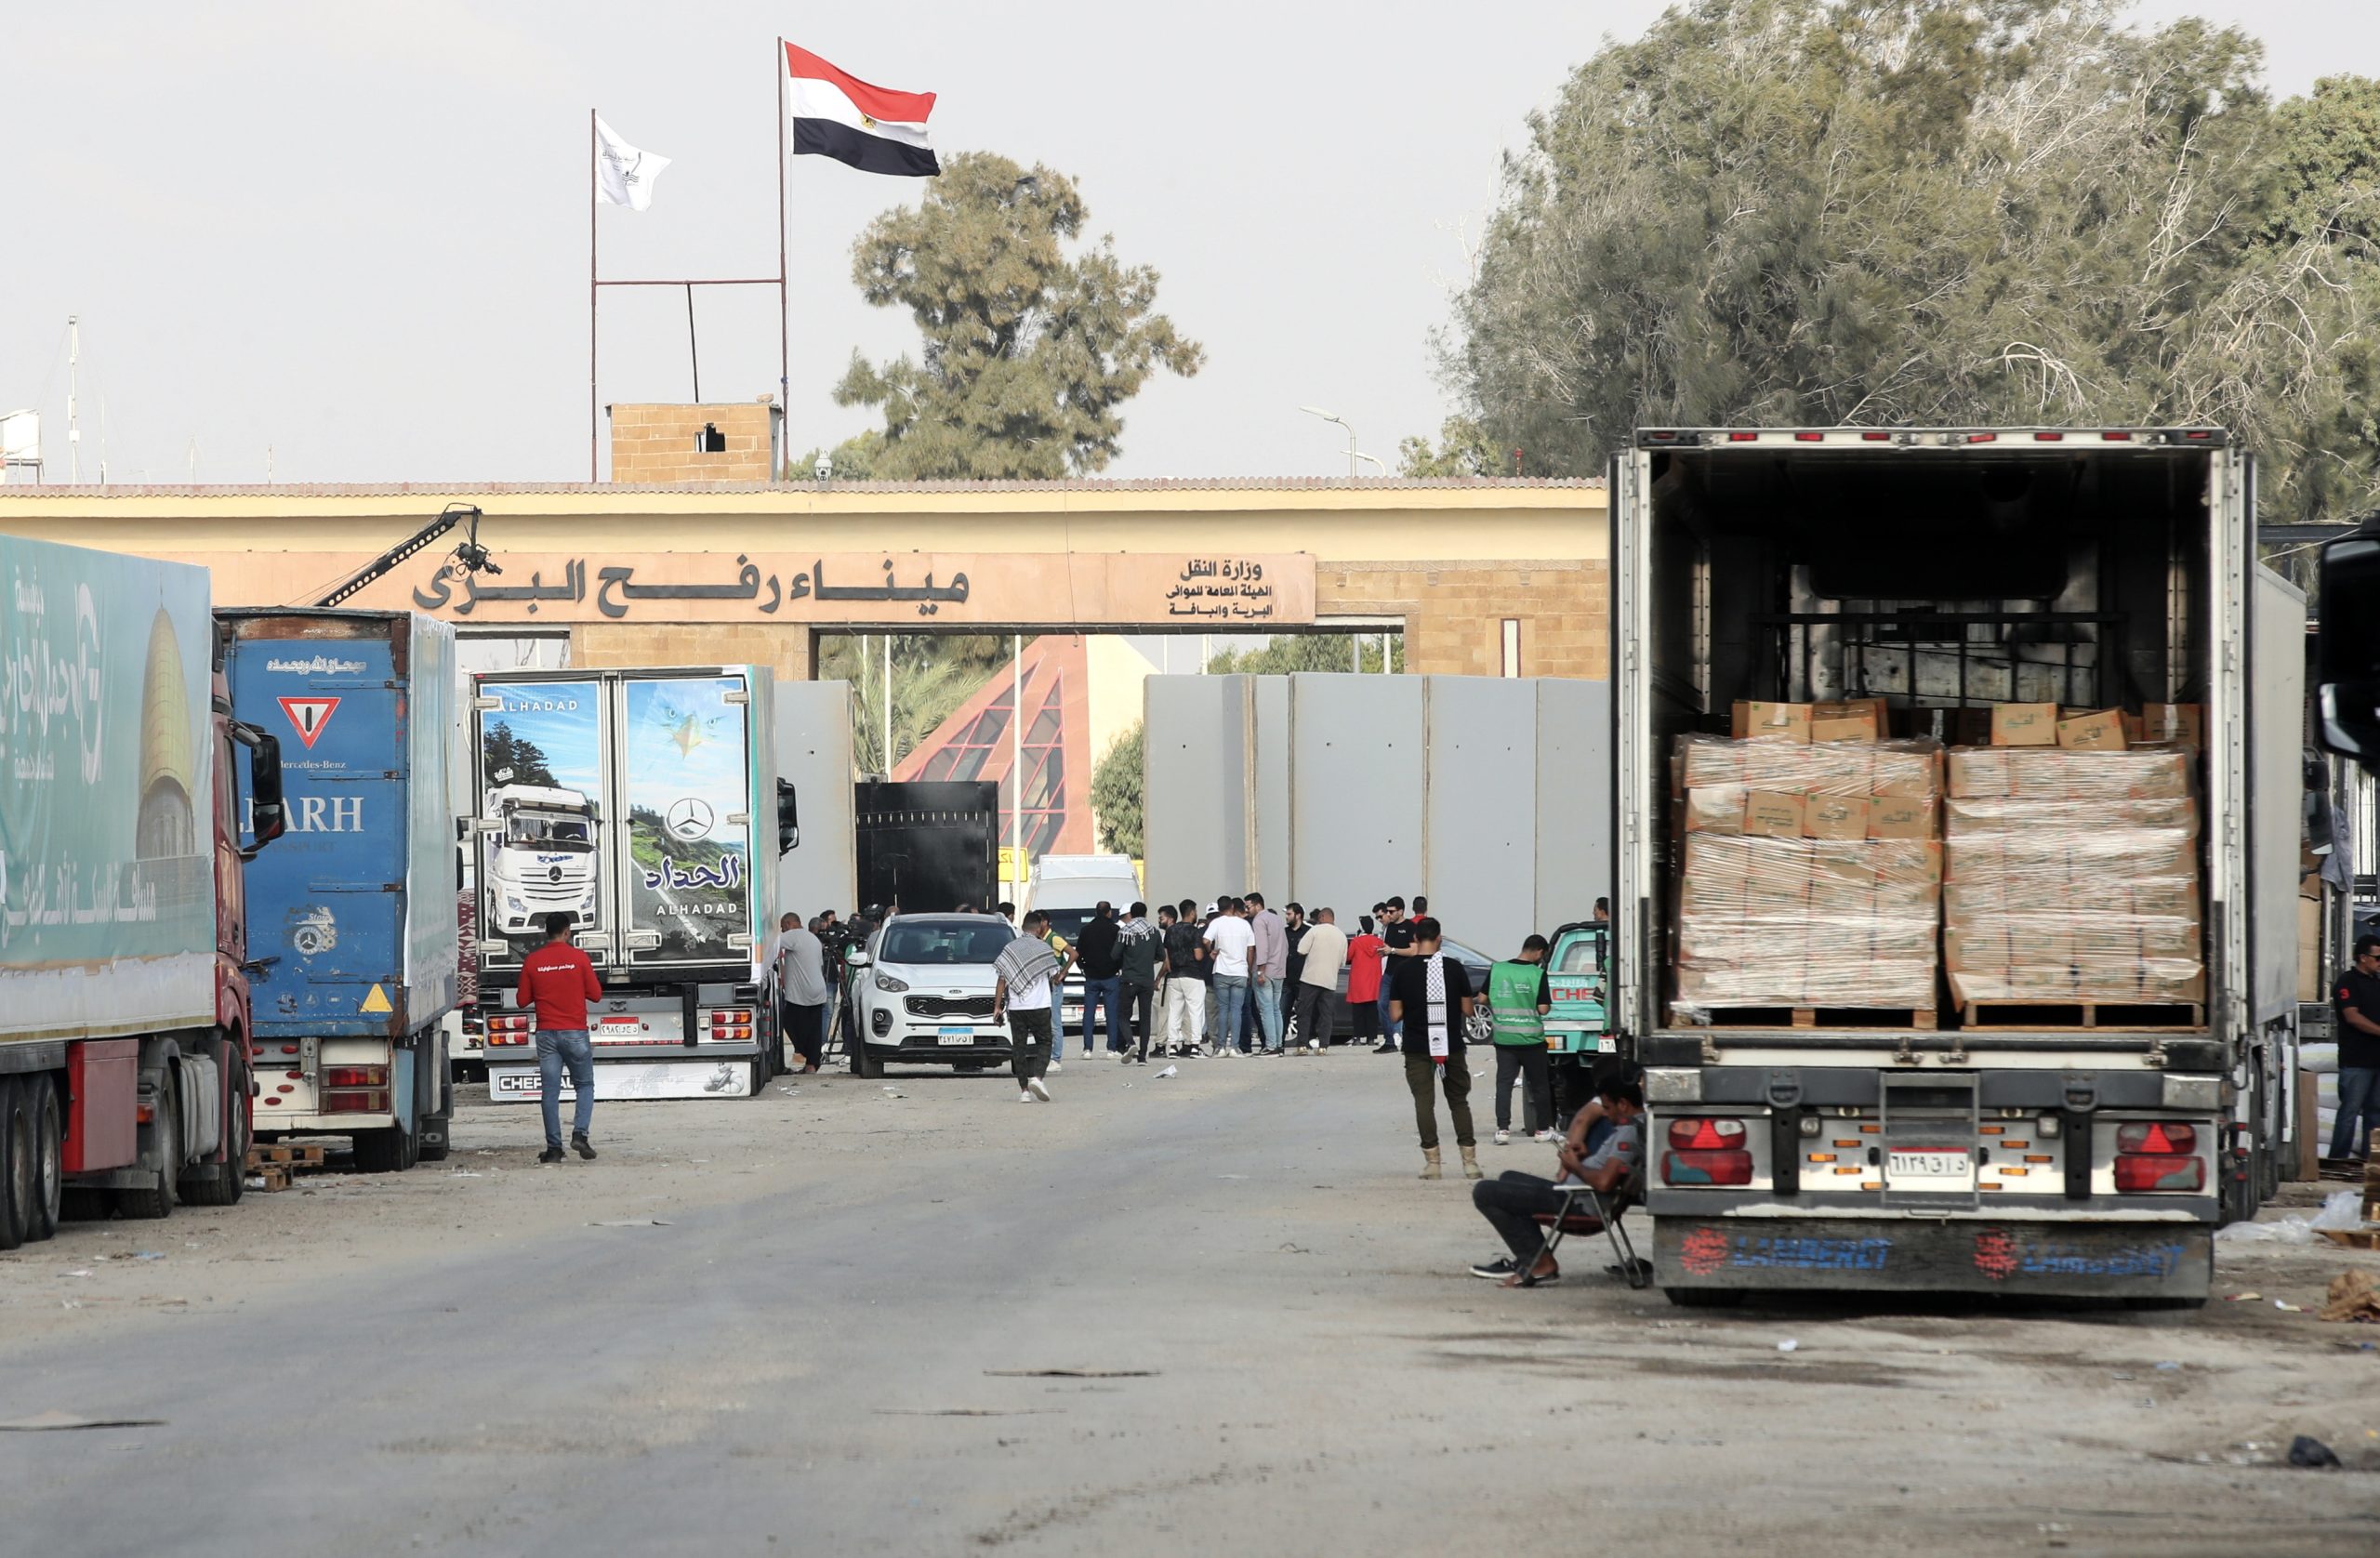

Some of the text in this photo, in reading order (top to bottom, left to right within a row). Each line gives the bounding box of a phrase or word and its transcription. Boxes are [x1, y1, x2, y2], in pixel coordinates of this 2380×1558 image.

[1180, 559, 1263, 581] وزارة النقل
[597, 554, 780, 618] رفح
[790, 557, 970, 615] ميناء
[1204, 585, 1238, 597] العامة
[1240, 584, 1272, 600] الهيئة
[1169, 602, 1273, 619] البرية والجافة
[310, 654, 327, 672] الله
[644, 854, 740, 890] الحداد
[655, 903, 737, 916] ALHADAD
[1552, 988, 1594, 1001] CHE
